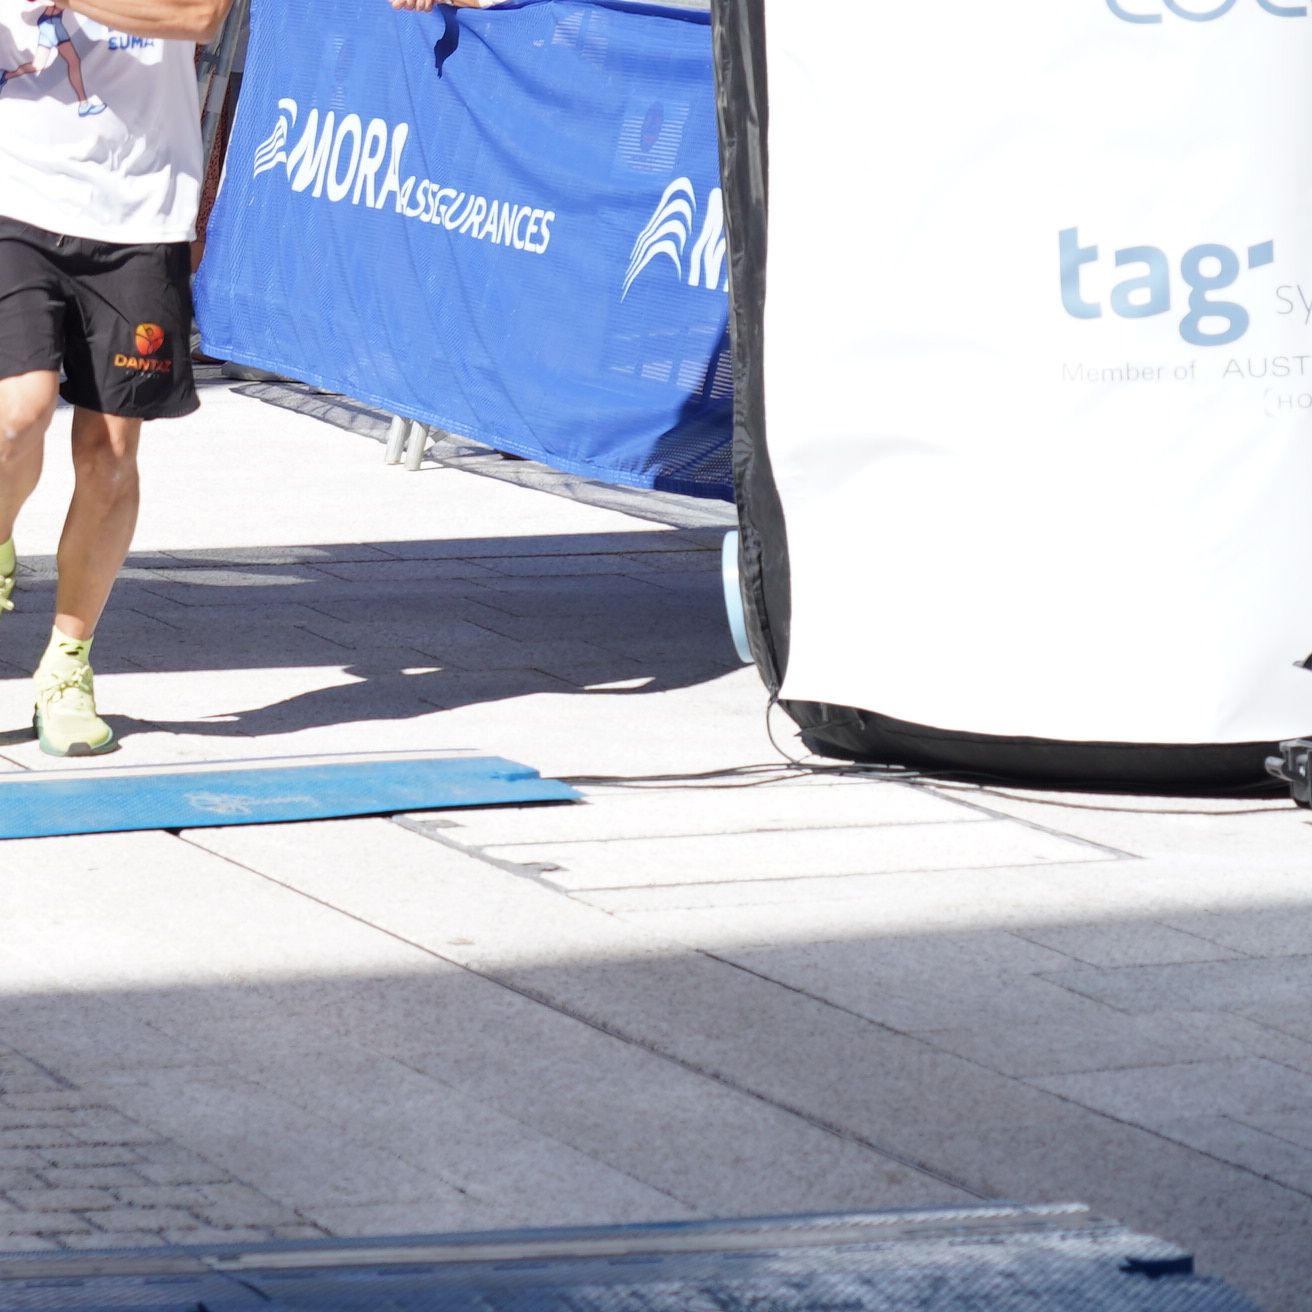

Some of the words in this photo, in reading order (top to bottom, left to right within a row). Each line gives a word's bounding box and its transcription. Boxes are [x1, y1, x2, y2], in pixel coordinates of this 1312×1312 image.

[287, 109, 409, 209] MORA
[401, 175, 555, 254] ASSEGURANCES
[1058, 226, 1252, 347] tag
[1061, 362, 1164, 383] Member
[1173, 359, 1198, 380] of
